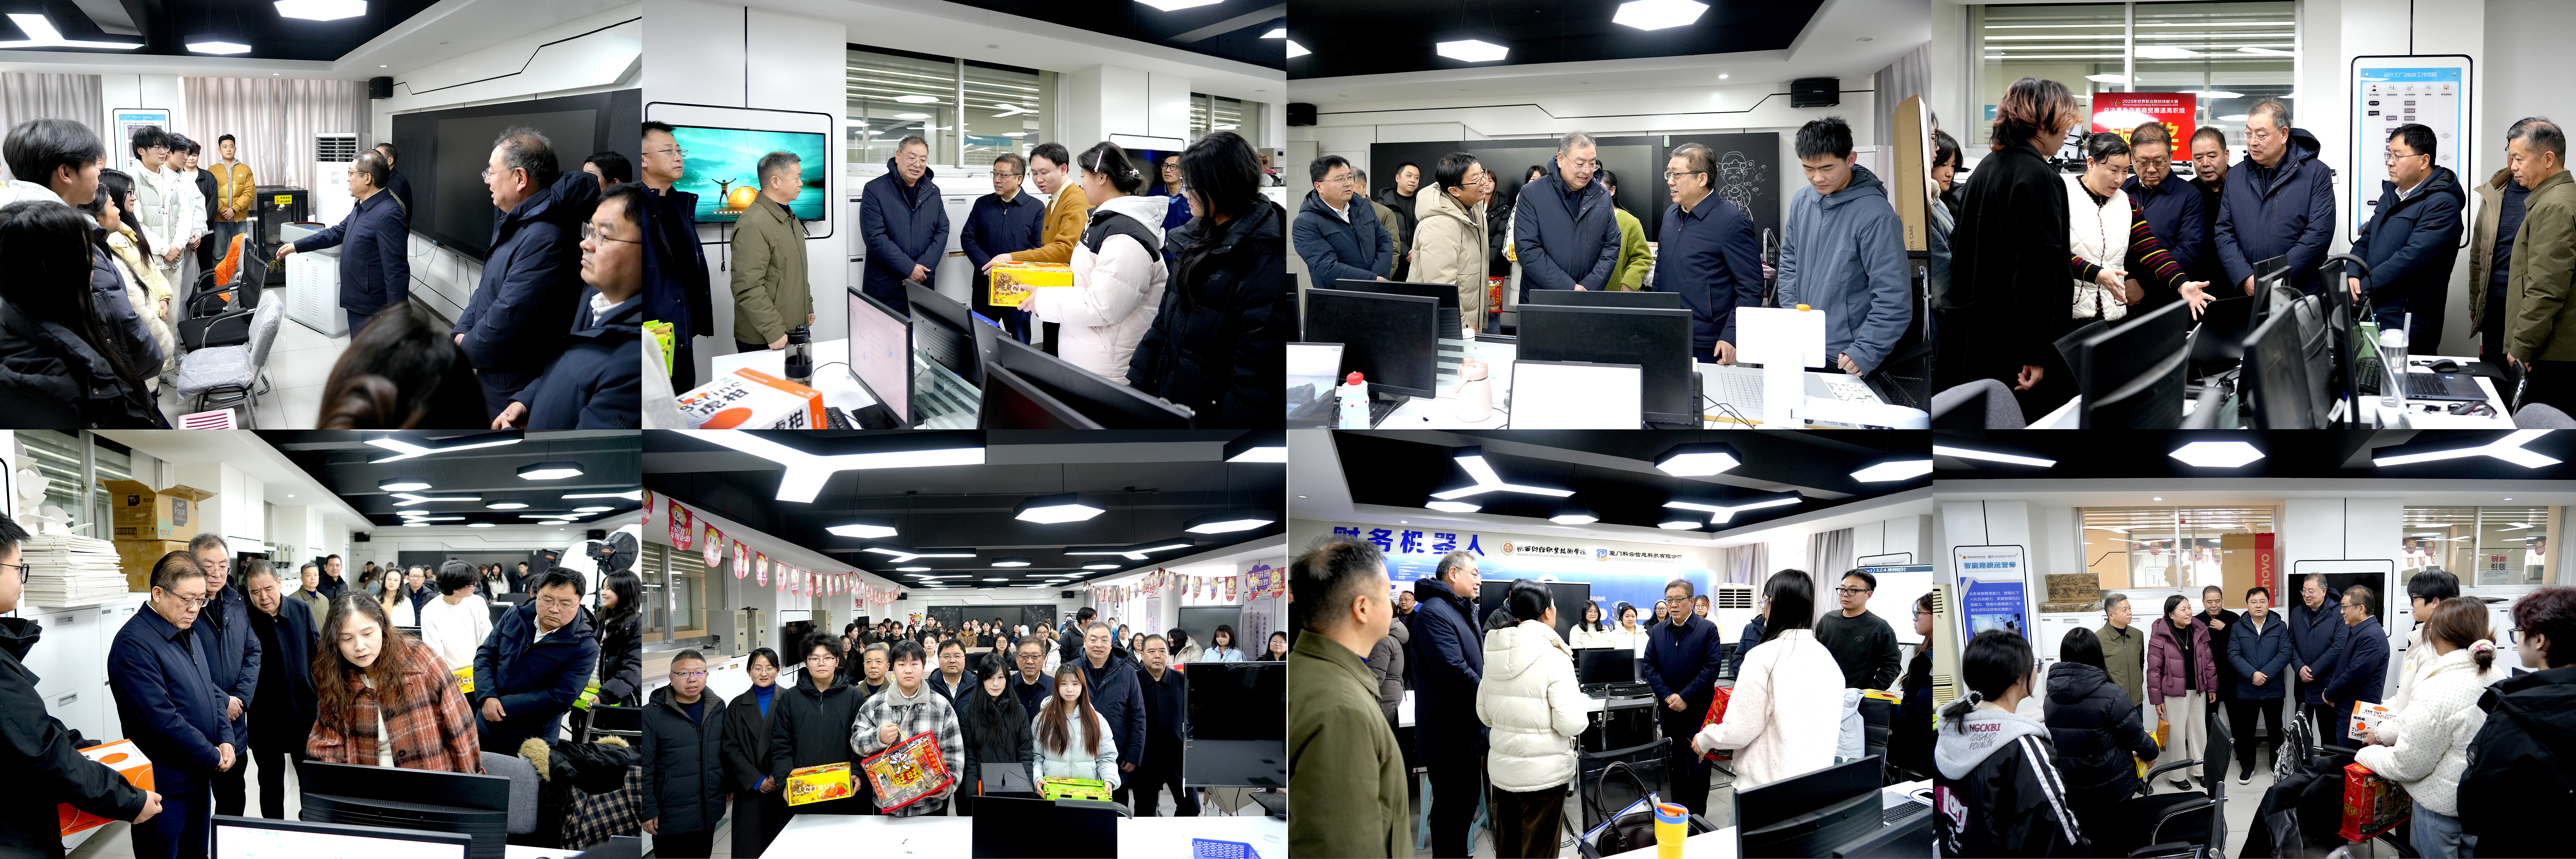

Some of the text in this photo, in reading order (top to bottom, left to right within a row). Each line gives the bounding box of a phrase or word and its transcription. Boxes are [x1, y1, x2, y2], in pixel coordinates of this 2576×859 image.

[175, 507, 185, 515] Face
[670, 526, 691, 536] 华为云双11
[670, 531, 691, 542] 年终钜惠
[1334, 526, 1485, 557] 财务机器人
[925, 747, 941, 771] 送礼送旺旺
[895, 767, 919, 785] 旺旺
[804, 782, 835, 793] CITRUS
[869, 773, 884, 797] 礼旺意更旺
